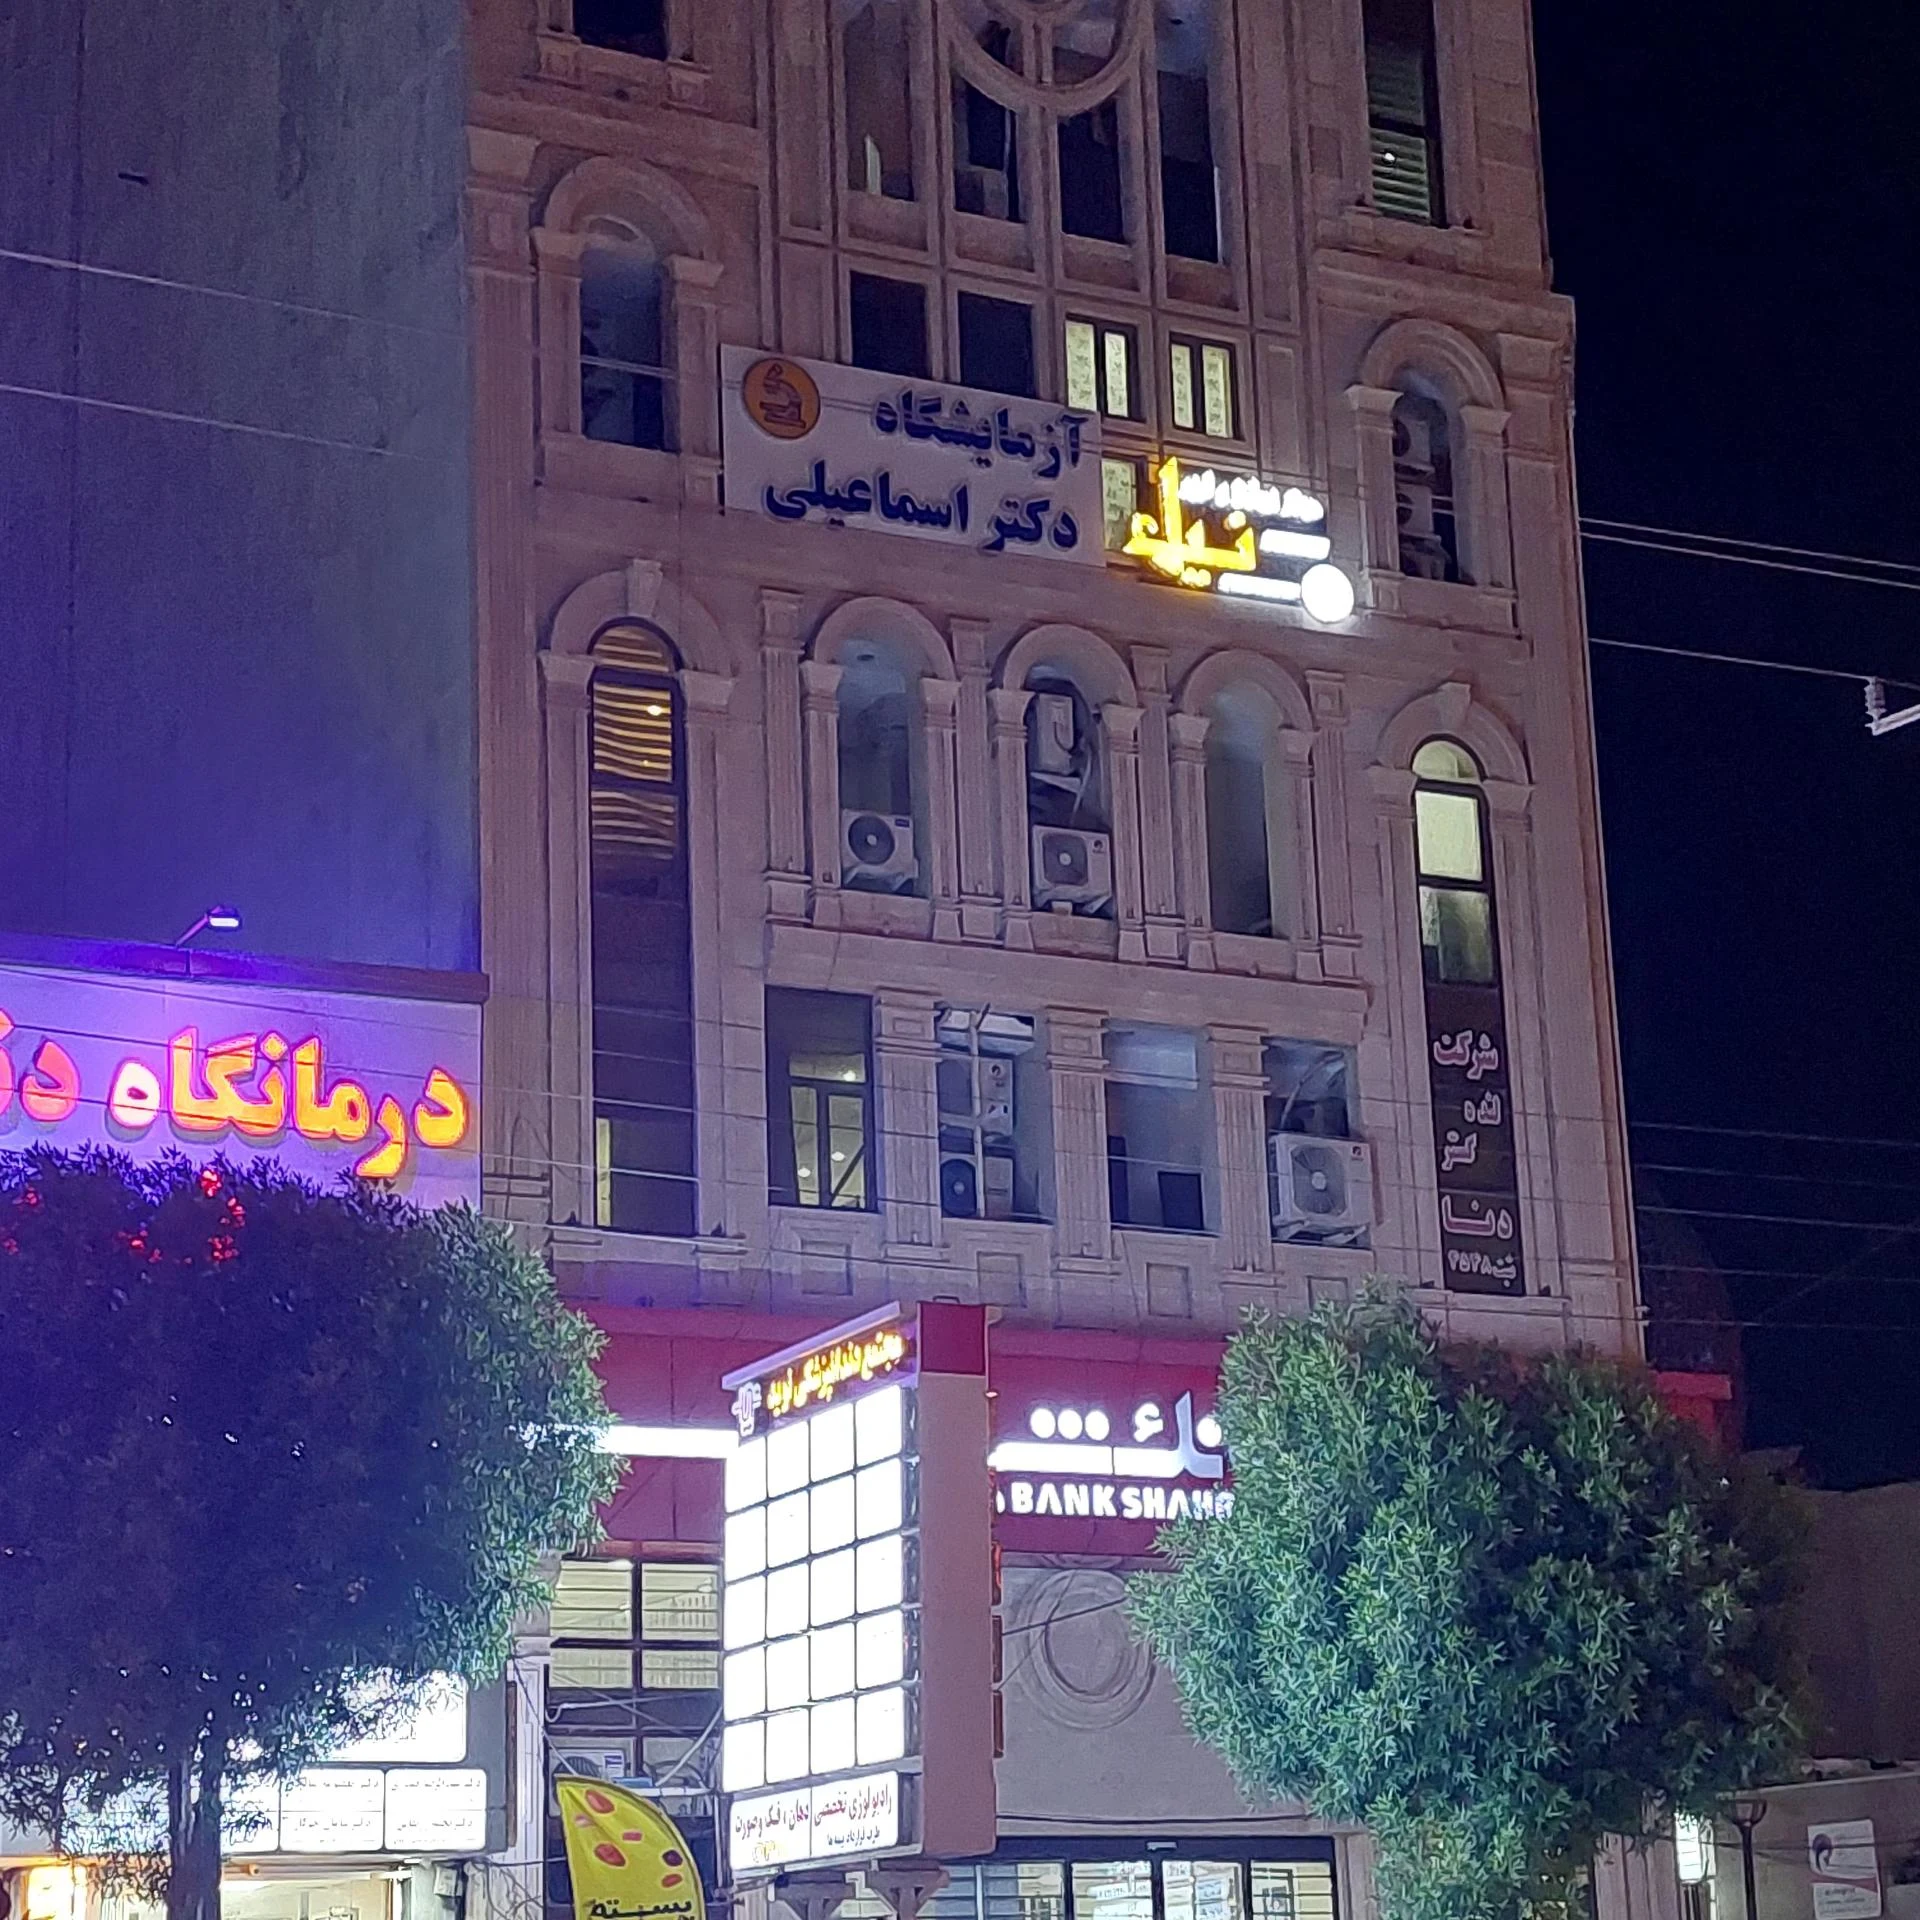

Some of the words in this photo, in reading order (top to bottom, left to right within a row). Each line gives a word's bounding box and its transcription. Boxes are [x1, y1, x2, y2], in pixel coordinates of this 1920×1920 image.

[873, 388, 1090, 480] آزمایشگاه
[764, 459, 970, 529] اسماعیلی
[983, 498, 1080, 551] دکتر
[1433, 1030, 1499, 1080] شرکت
[109, 1025, 469, 1179] درمانگاه
[1441, 1194, 1513, 1239] دنا
[814, 1791, 848, 1827] تخصصی
[848, 1783, 892, 1820] رادیولوژی
